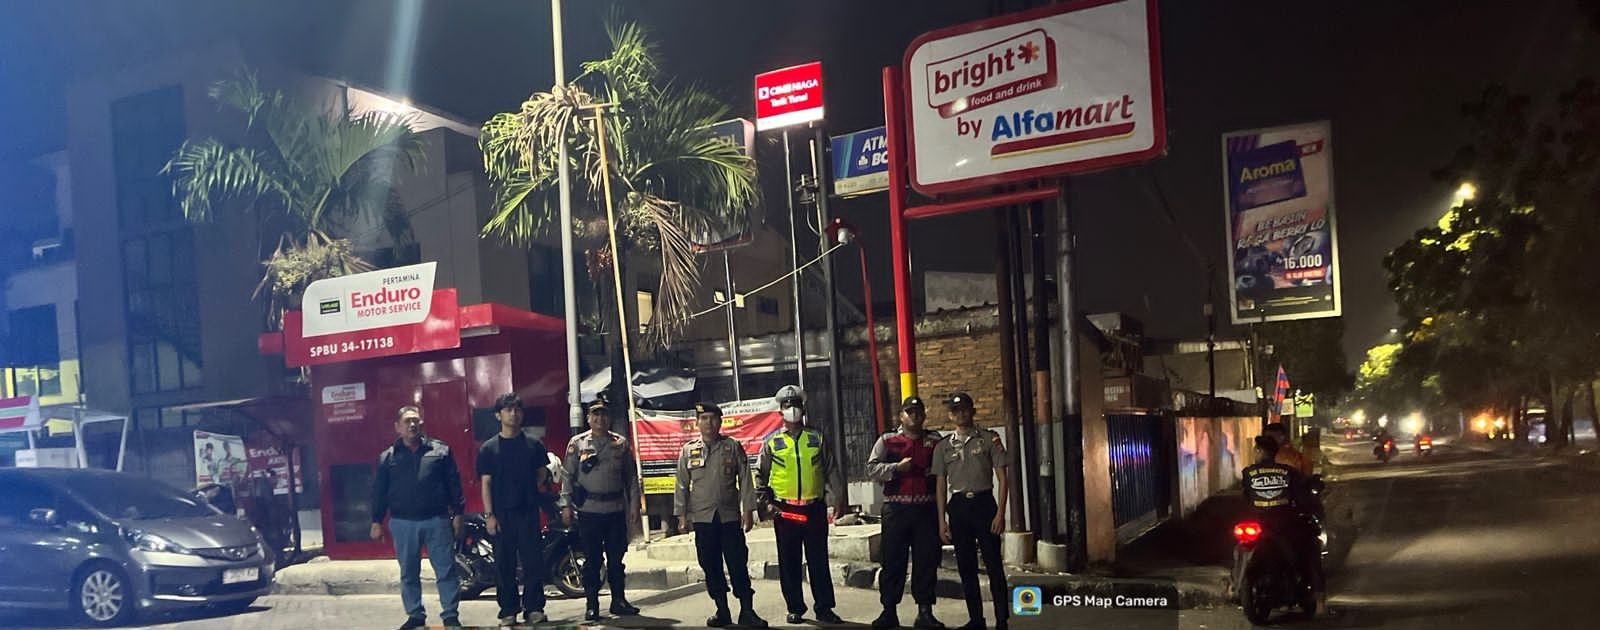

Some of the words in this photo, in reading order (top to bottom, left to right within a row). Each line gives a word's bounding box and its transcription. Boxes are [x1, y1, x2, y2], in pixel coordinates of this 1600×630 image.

[934, 47, 1015, 95] bright
[970, 92, 993, 107] food
[995, 86, 1014, 101] and
[1016, 78, 1042, 94] drink
[957, 117, 982, 138] by
[991, 94, 1135, 141] Alfamart
[872, 151, 888, 166] BC
[1240, 158, 1296, 183] Aroma
[1283, 254, 1323, 270] 16.000
[382, 273, 420, 285] PERTAMINA
[351, 286, 421, 309] Enduro
[357, 307, 388, 318] MOTOR
[389, 301, 422, 314] SERVICE
[310, 343, 338, 358] SPBU
[341, 336, 394, 352] 34-17138
